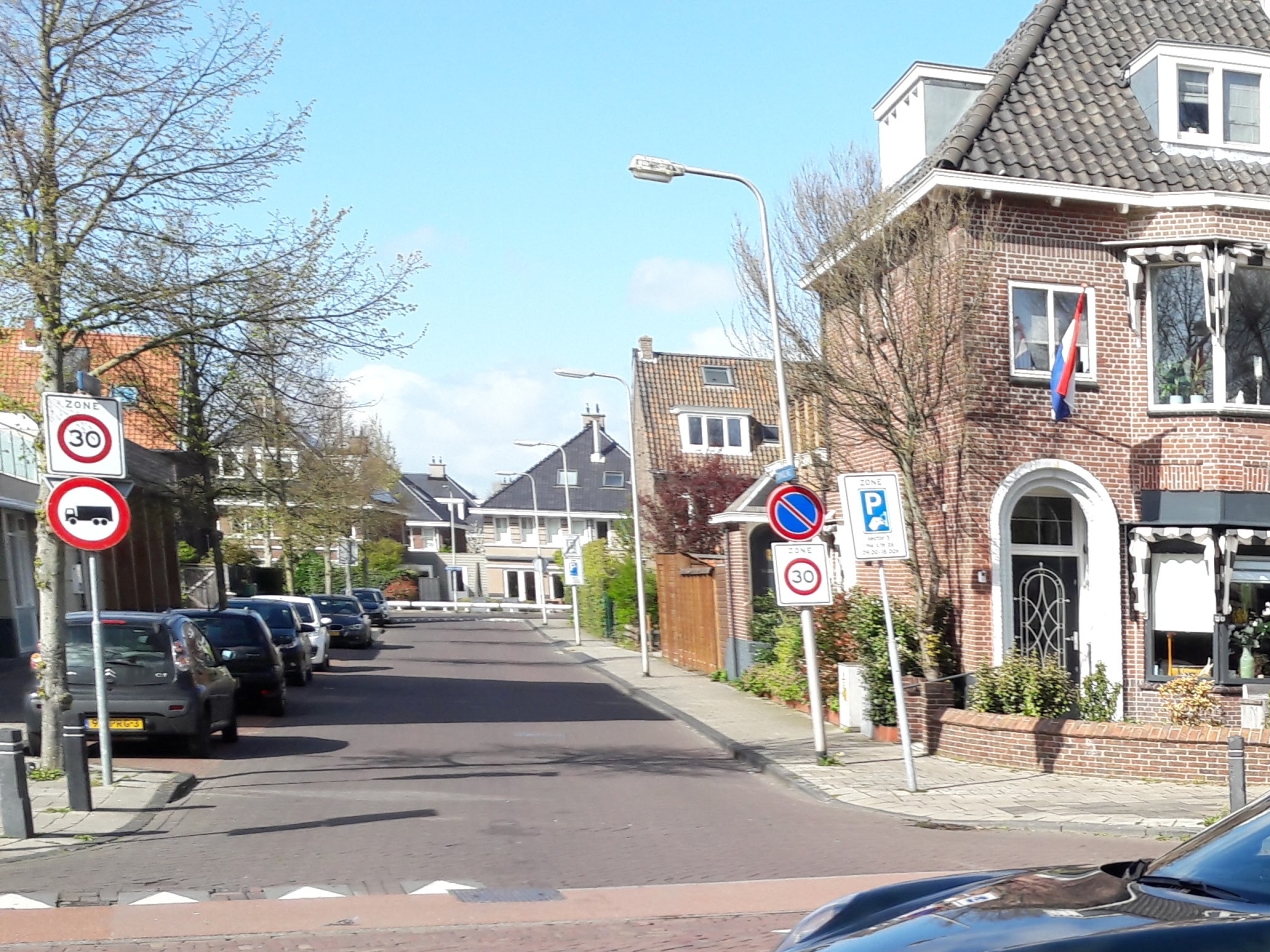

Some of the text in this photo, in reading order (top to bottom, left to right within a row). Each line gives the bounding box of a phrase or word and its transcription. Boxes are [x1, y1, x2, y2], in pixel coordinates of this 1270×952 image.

[65, 400, 100, 410] ZONE
[69, 429, 101, 448] 30
[865, 492, 882, 515] P
[792, 570, 814, 583] 30
